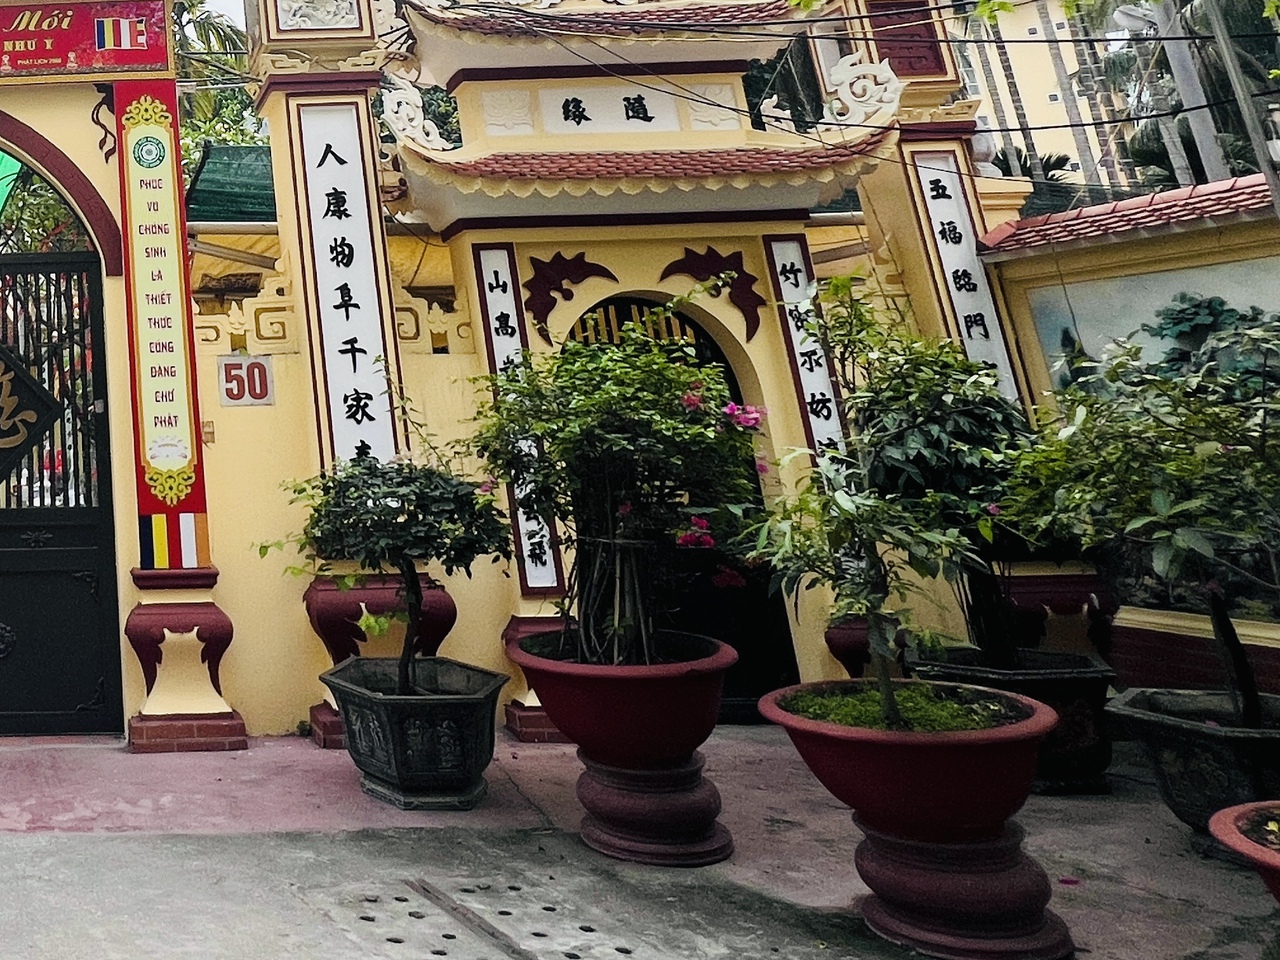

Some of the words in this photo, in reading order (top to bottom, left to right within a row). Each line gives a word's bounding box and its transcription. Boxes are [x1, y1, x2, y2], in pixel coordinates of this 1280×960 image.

[2, 9, 75, 33] Mới
[3, 38, 38, 53] NHƯ
[144, 246, 167, 259] SINH
[929, 178, 998, 370] 五福臨門
[224, 362, 269, 401] 50
[154, 388, 175, 402] CHƯ
